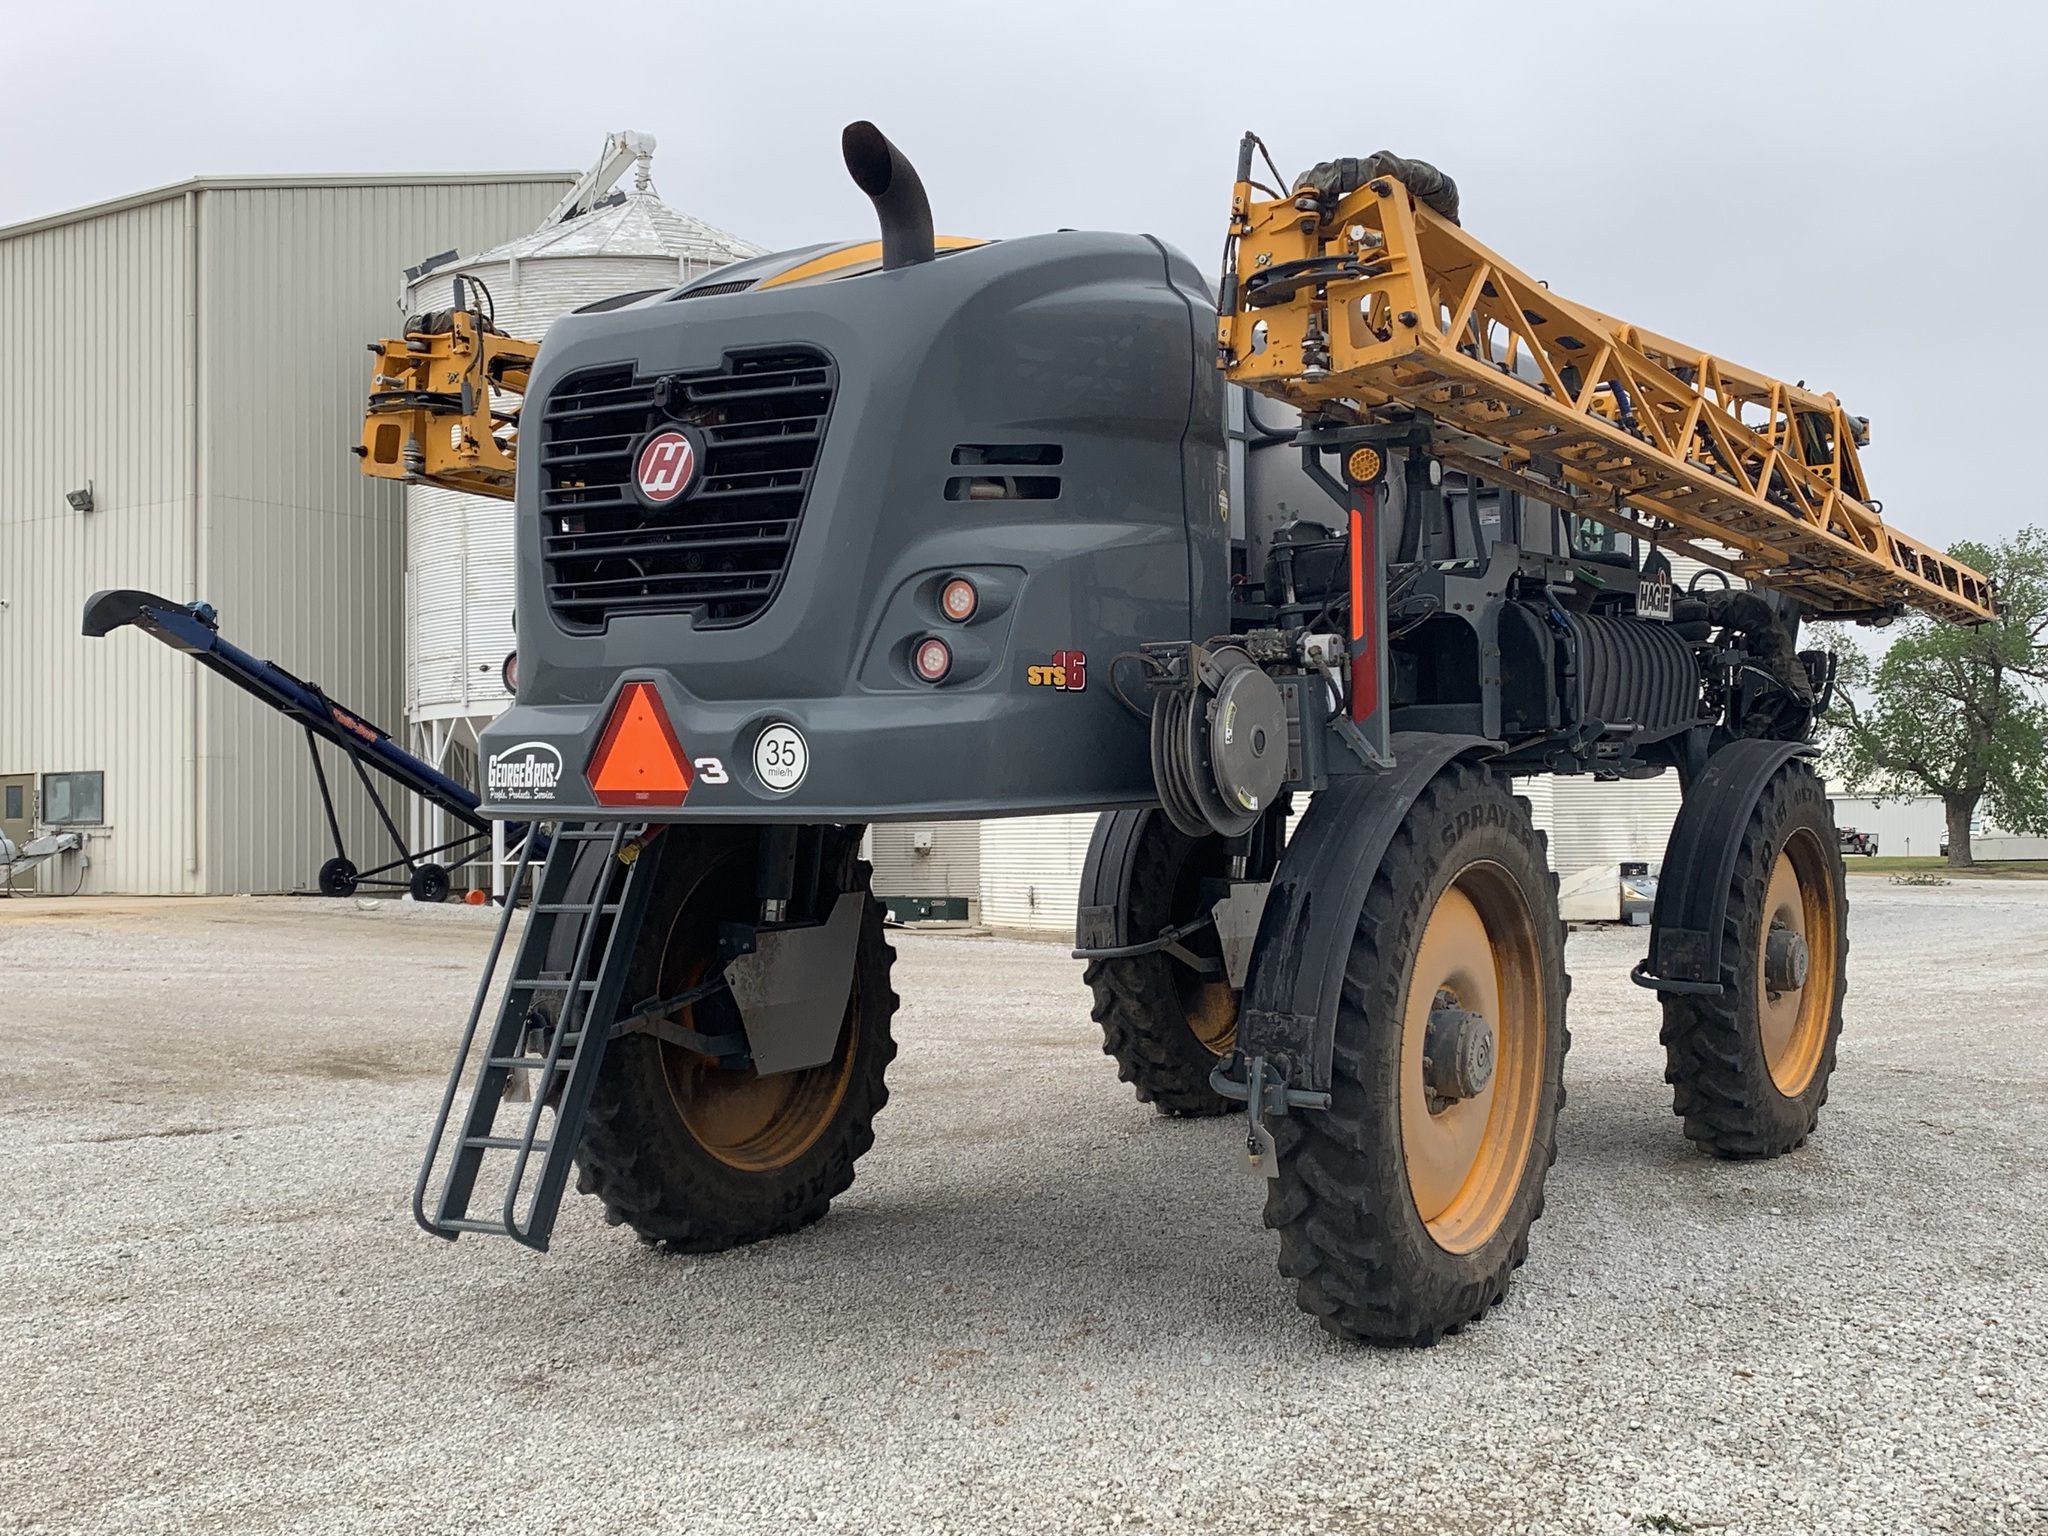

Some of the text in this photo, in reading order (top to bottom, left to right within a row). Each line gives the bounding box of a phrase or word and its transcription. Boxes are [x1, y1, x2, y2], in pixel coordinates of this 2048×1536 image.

[1638, 573, 1671, 614] HAGIE
[766, 739, 795, 766] 35
[694, 757, 729, 784] 3
[767, 767, 793, 777] mile/h
[1440, 803, 1534, 852] SPRAYER
